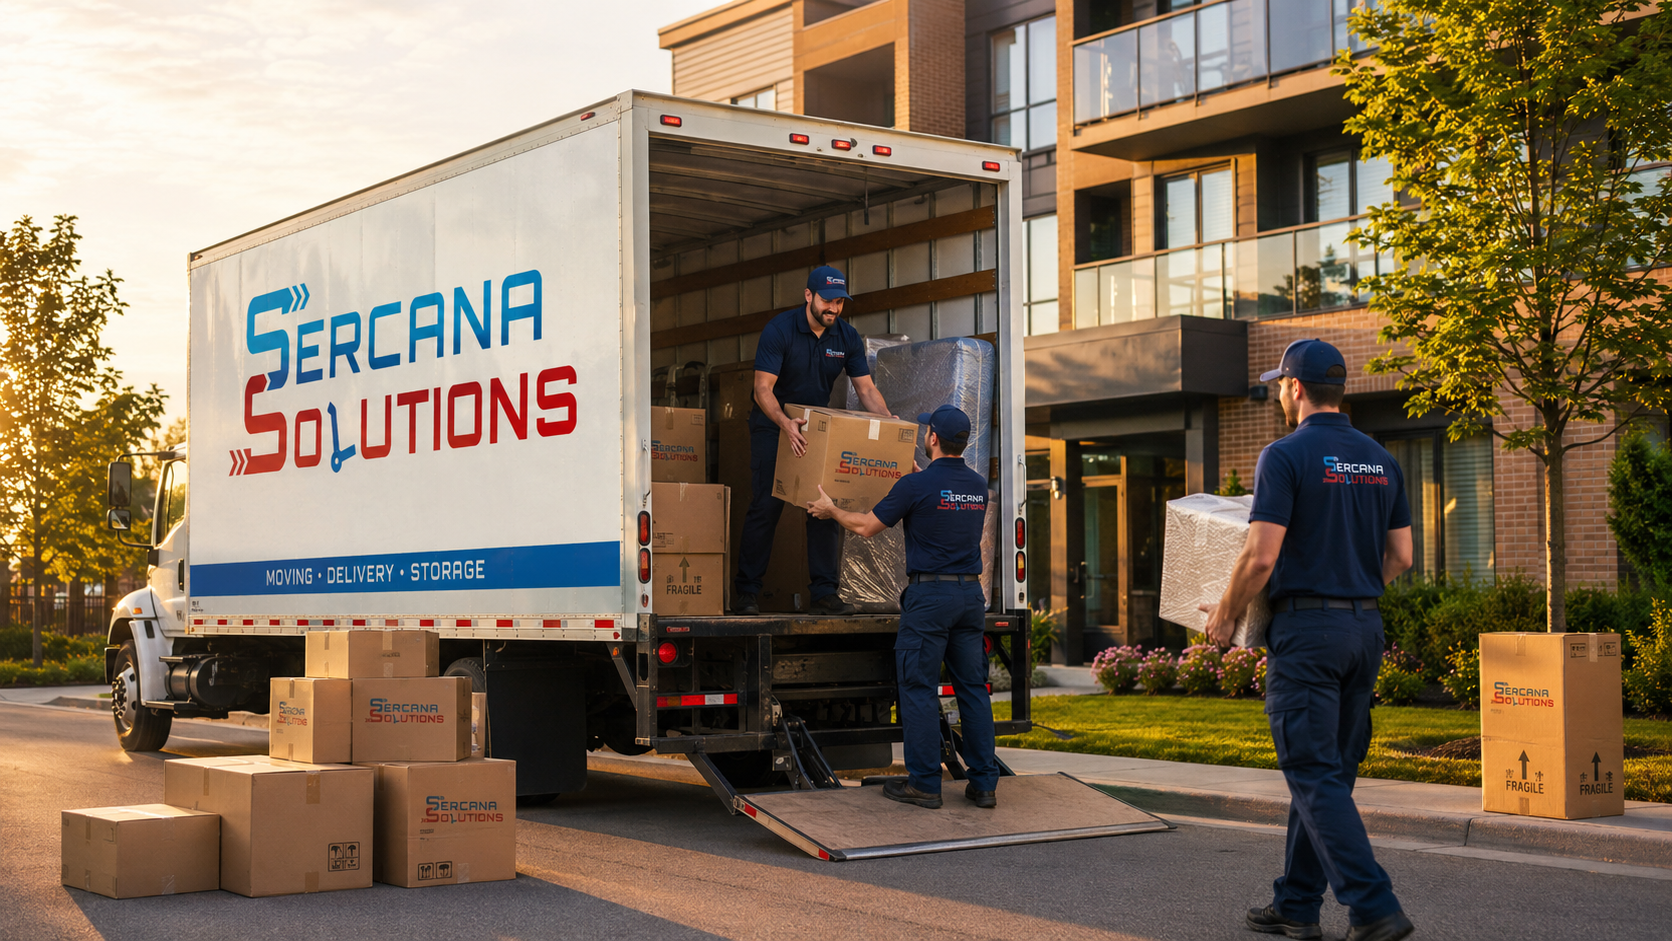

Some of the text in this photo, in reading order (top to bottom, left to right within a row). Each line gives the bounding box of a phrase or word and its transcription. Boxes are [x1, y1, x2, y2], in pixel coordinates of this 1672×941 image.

[246, 269, 543, 391] SERCANA
[243, 365, 578, 476] SOLUTIONS
[841, 451, 898, 470] SERCANA
[1323, 456, 1384, 474] SERCANA
[837, 460, 902, 479] SOLUTIONS
[1324, 468, 1389, 485] SOLUTIONS
[940, 490, 984, 503] SERCANA
[266, 560, 486, 587] MOVING DELIVERY STORAGE
[666, 584, 702, 595] FRAGILE
[1494, 681, 1549, 698] SERCANA
[369, 698, 439, 713] SERCANA
[1493, 691, 1555, 708] SOLUTIONS
[368, 708, 445, 724] SOLUTIONS
[1505, 780, 1545, 795] FRAGILE
[1579, 782, 1613, 795] FRAGILE
[426, 795, 497, 811] SERCANA
[425, 807, 504, 824] SOLUTIONS
